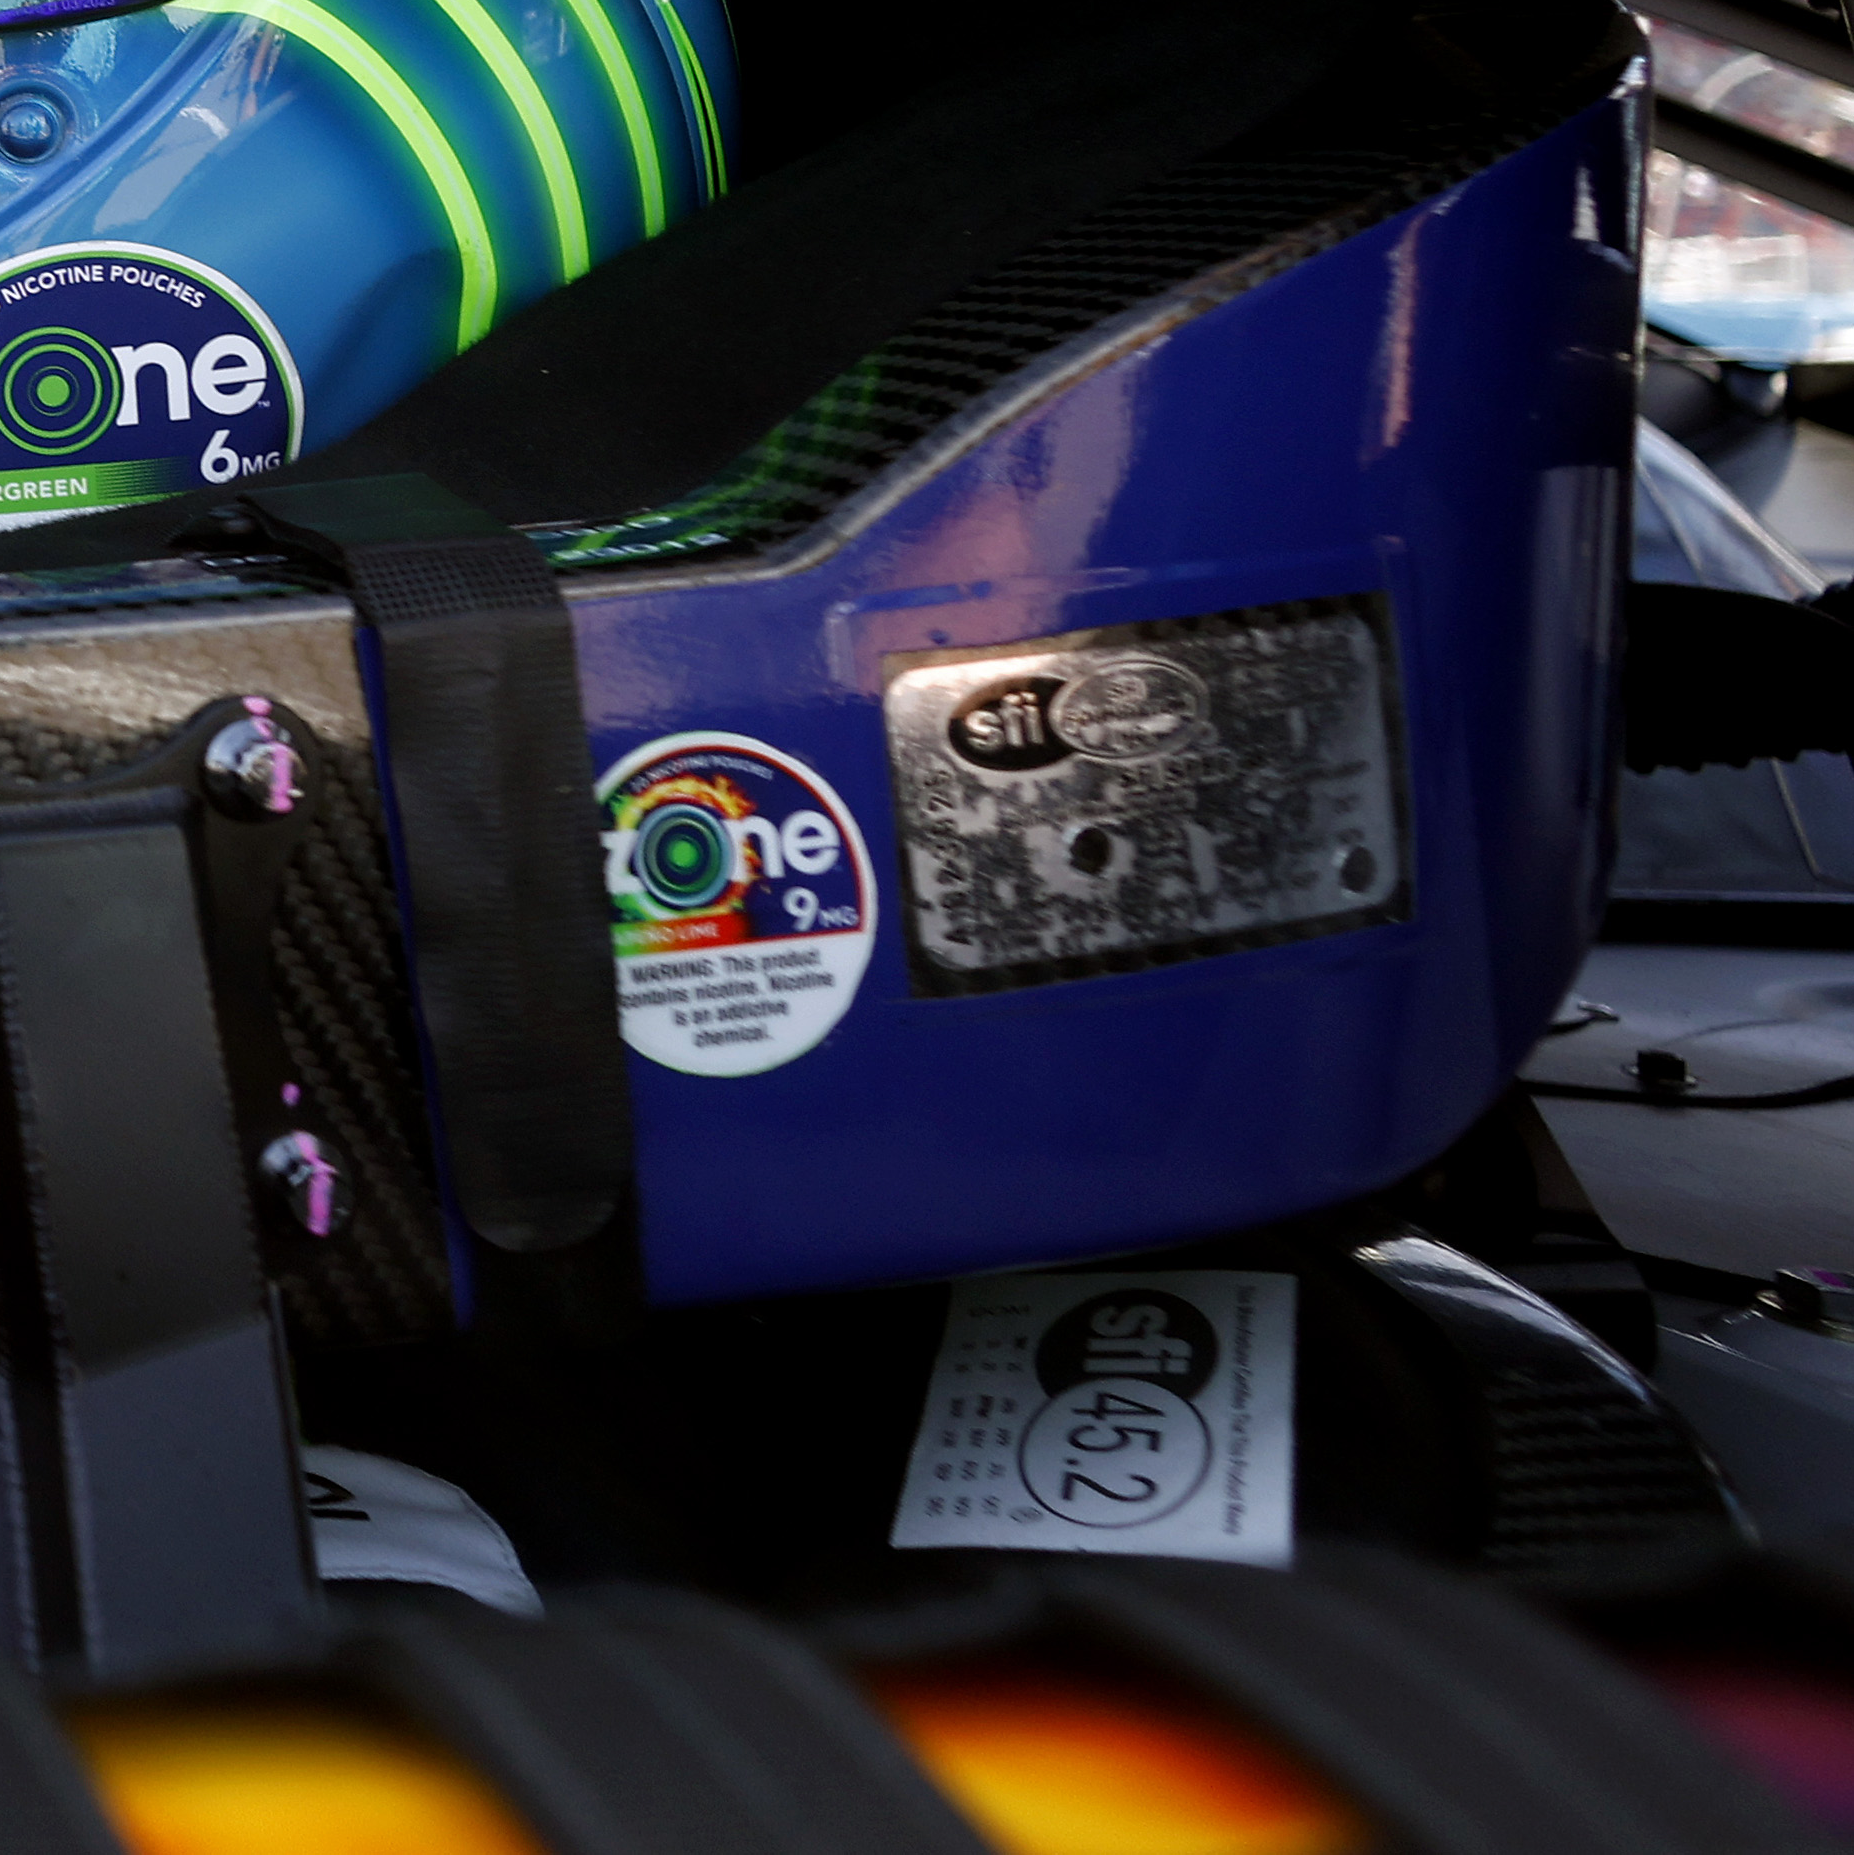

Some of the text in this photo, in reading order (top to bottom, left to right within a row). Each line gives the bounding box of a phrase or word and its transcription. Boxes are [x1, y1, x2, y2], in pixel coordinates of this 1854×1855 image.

[0, 264, 104, 305] NICOTINE
[109, 264, 207, 309] POUCHES
[964, 690, 1046, 748] sfi
[721, 955, 757, 974] This
[761, 947, 820, 971] product
[768, 972, 835, 992] Nicotine
[1060, 1303, 1193, 1503] sfi 45.2
